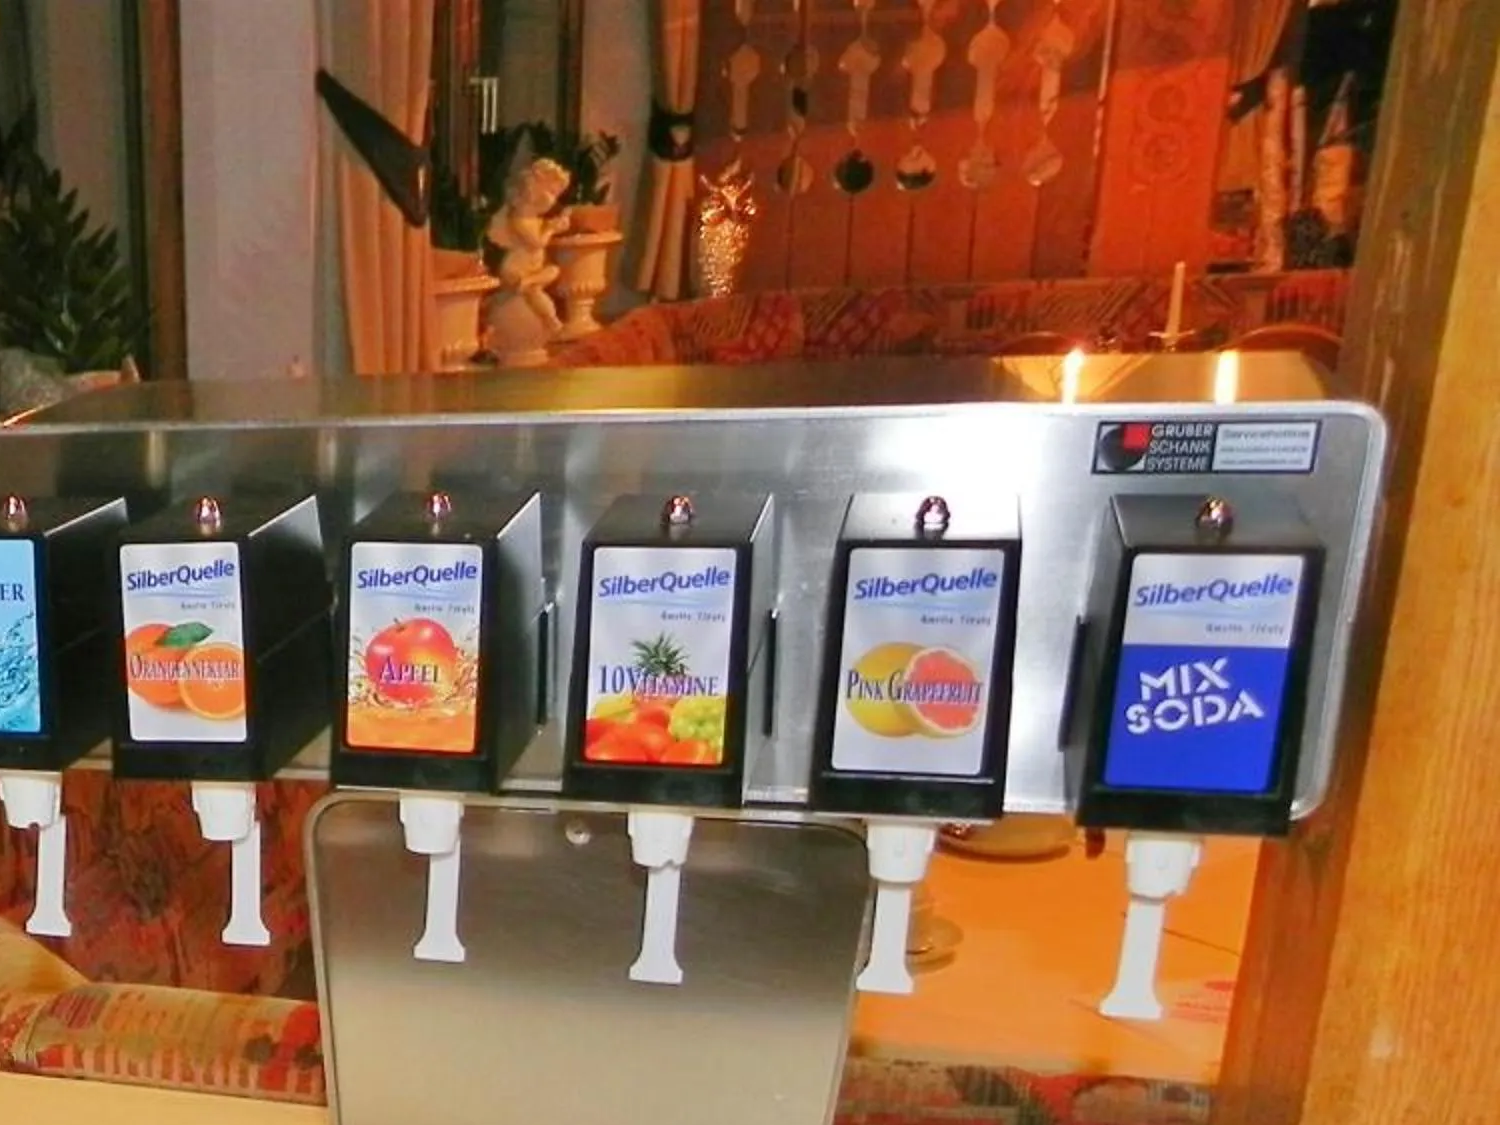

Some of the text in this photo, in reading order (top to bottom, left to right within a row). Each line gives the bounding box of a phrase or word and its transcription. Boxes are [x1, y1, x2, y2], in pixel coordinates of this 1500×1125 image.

[1151, 423, 1213, 438] GRUBER
[1148, 439, 1210, 454] SCHANK
[1146, 455, 1205, 471] SYSTEME
[127, 559, 235, 591] SilberQuelle
[357, 561, 477, 589] SilberQuelle
[599, 566, 730, 597] SilberQuelle
[854, 567, 997, 599] SilberQuelle
[1134, 573, 1293, 606] SilberQuelle
[1139, 657, 1230, 701] MIX
[1126, 689, 1264, 735] SODA
